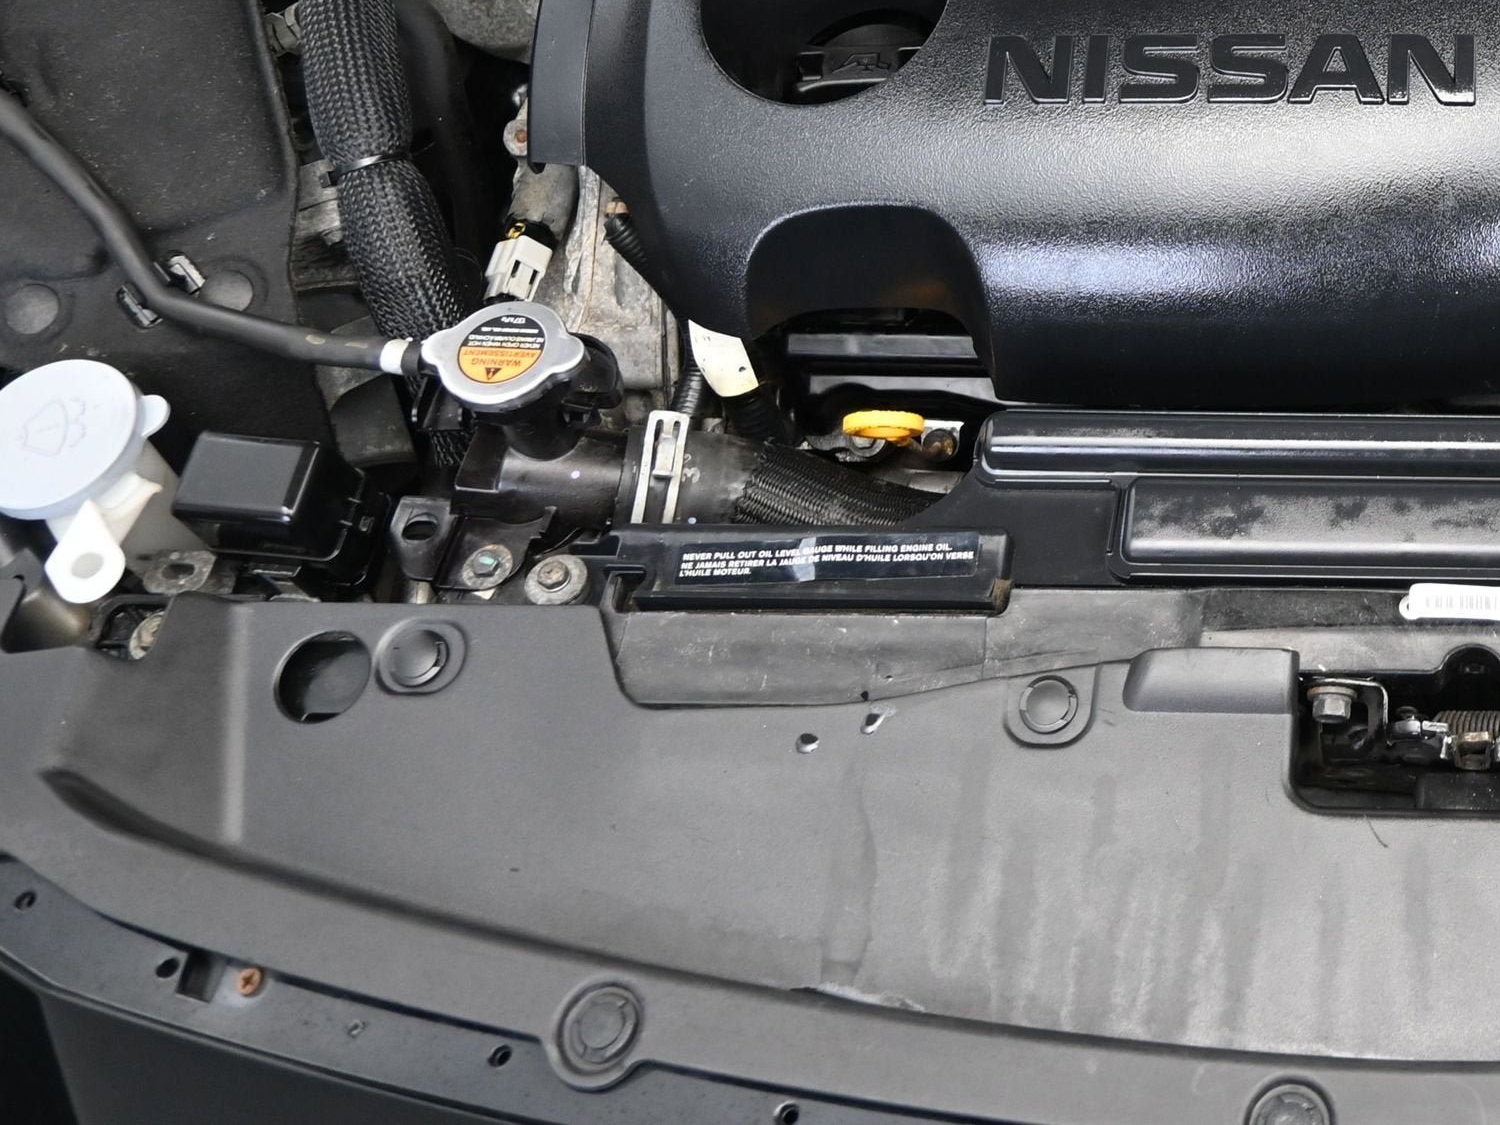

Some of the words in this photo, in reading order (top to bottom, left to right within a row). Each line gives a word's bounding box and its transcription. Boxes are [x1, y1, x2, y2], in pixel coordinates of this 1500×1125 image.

[984, 34, 1477, 106] NISSAN
[464, 349, 537, 358] AVERTISSEMENT
[472, 358, 521, 367] WARNING
[683, 553, 712, 561] NEVER
[738, 551, 756, 559] OUT
[758, 550, 773, 558] OIL
[775, 548, 801, 557] LEVEL
[802, 545, 833, 554] GAUGE
[834, 544, 863, 553] WHILE
[864, 544, 898, 553] FILLING
[900, 543, 934, 552] ENGINE
[935, 543, 953, 551] OIL.
[681, 562, 694, 570] NE
[695, 561, 726, 569] JAMAIS
[728, 560, 764, 568] RETIRER
[766, 559, 778, 567] LA
[779, 557, 807, 566] JAUGE
[808, 555, 820, 563] DE
[821, 554, 854, 562] NIVEAU
[856, 553, 891, 562] D'HUILE
[892, 553, 943, 562] LORSQU'ON
[945, 551, 974, 560] VERSE
[679, 569, 711, 577] L'HUILE
[713, 568, 752, 576] MOTEUR.
